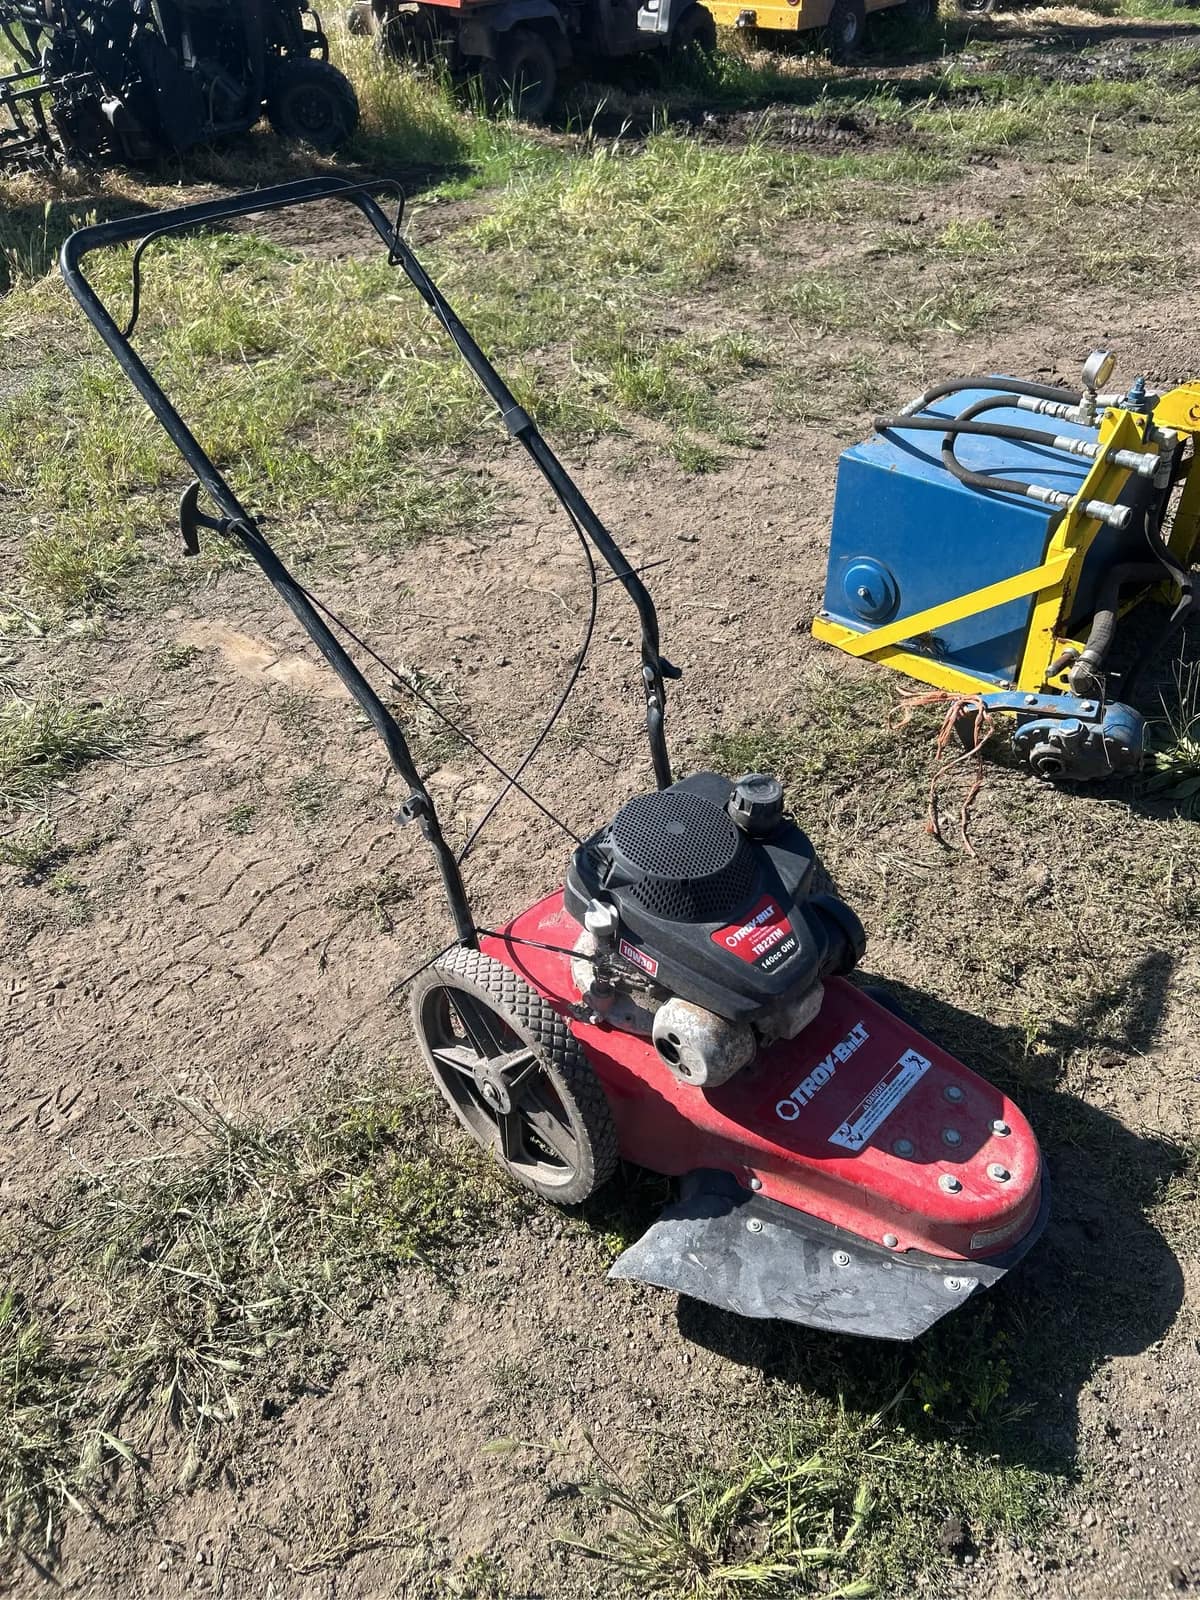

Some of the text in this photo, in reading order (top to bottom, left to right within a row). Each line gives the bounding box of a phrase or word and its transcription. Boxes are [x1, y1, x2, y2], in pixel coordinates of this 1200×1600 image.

[733, 905, 775, 943] TROY-BILT
[752, 928, 785, 955] TB22TM
[761, 938, 796, 968] 140cc OHV
[623, 945, 653, 970] 10W30
[866, 1081, 888, 1105] DANGER
